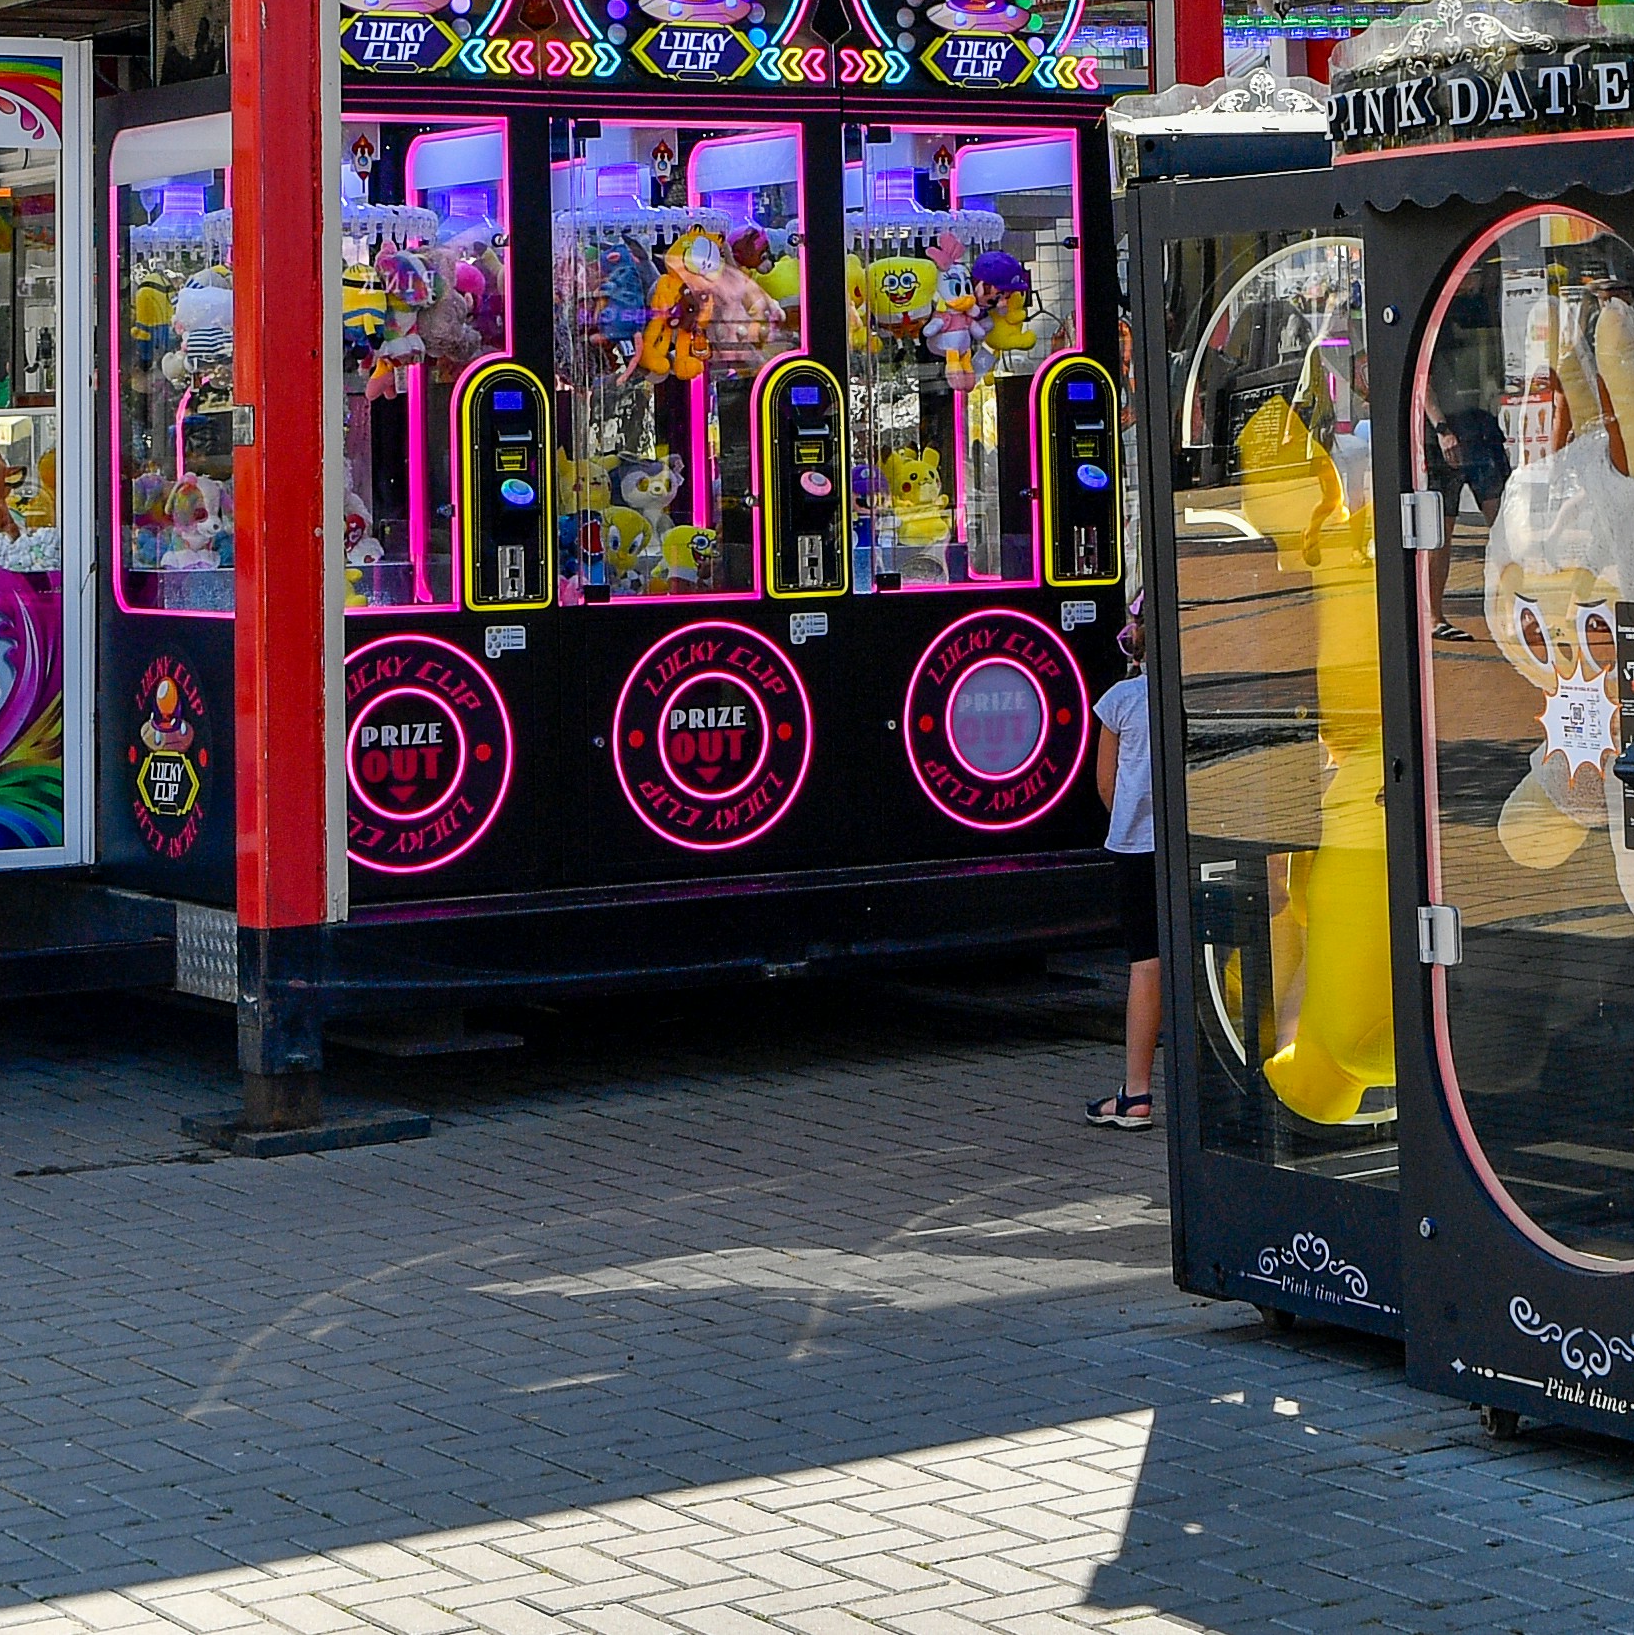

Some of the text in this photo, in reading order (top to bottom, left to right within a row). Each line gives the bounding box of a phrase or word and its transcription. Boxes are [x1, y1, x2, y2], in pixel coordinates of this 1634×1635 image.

[353, 22, 435, 45] LUCKY
[659, 31, 733, 52] LUCKY
[945, 37, 1020, 58] LUCKY
[365, 42, 419, 62] CLIP
[667, 48, 721, 69] CLIP
[952, 56, 1003, 77] CLIP
[1325, 77, 1437, 141] PINK
[642, 640, 788, 697] LUCKY CLIP
[927, 628, 1061, 685] LUCKY CLIP
[346, 656, 482, 710] UCKY CLIP
[958, 691, 1027, 712] PRIZE
[670, 706, 746, 730] PRIZE
[959, 714, 1028, 746] OUT
[361, 723, 444, 747] PRIZE
[670, 729, 746, 764] OUT
[150, 761, 185, 782] LUCKY
[361, 747, 444, 783] OUT
[153, 782, 180, 802] CLIP
[924, 757, 1058, 811] LUCKY CLIP
[638, 771, 784, 831] LUCKY CLIP
[386, 796, 475, 853] LUCKY
[1281, 1274, 1344, 1306] Pink time
[1545, 1376, 1628, 1414] Pink time
